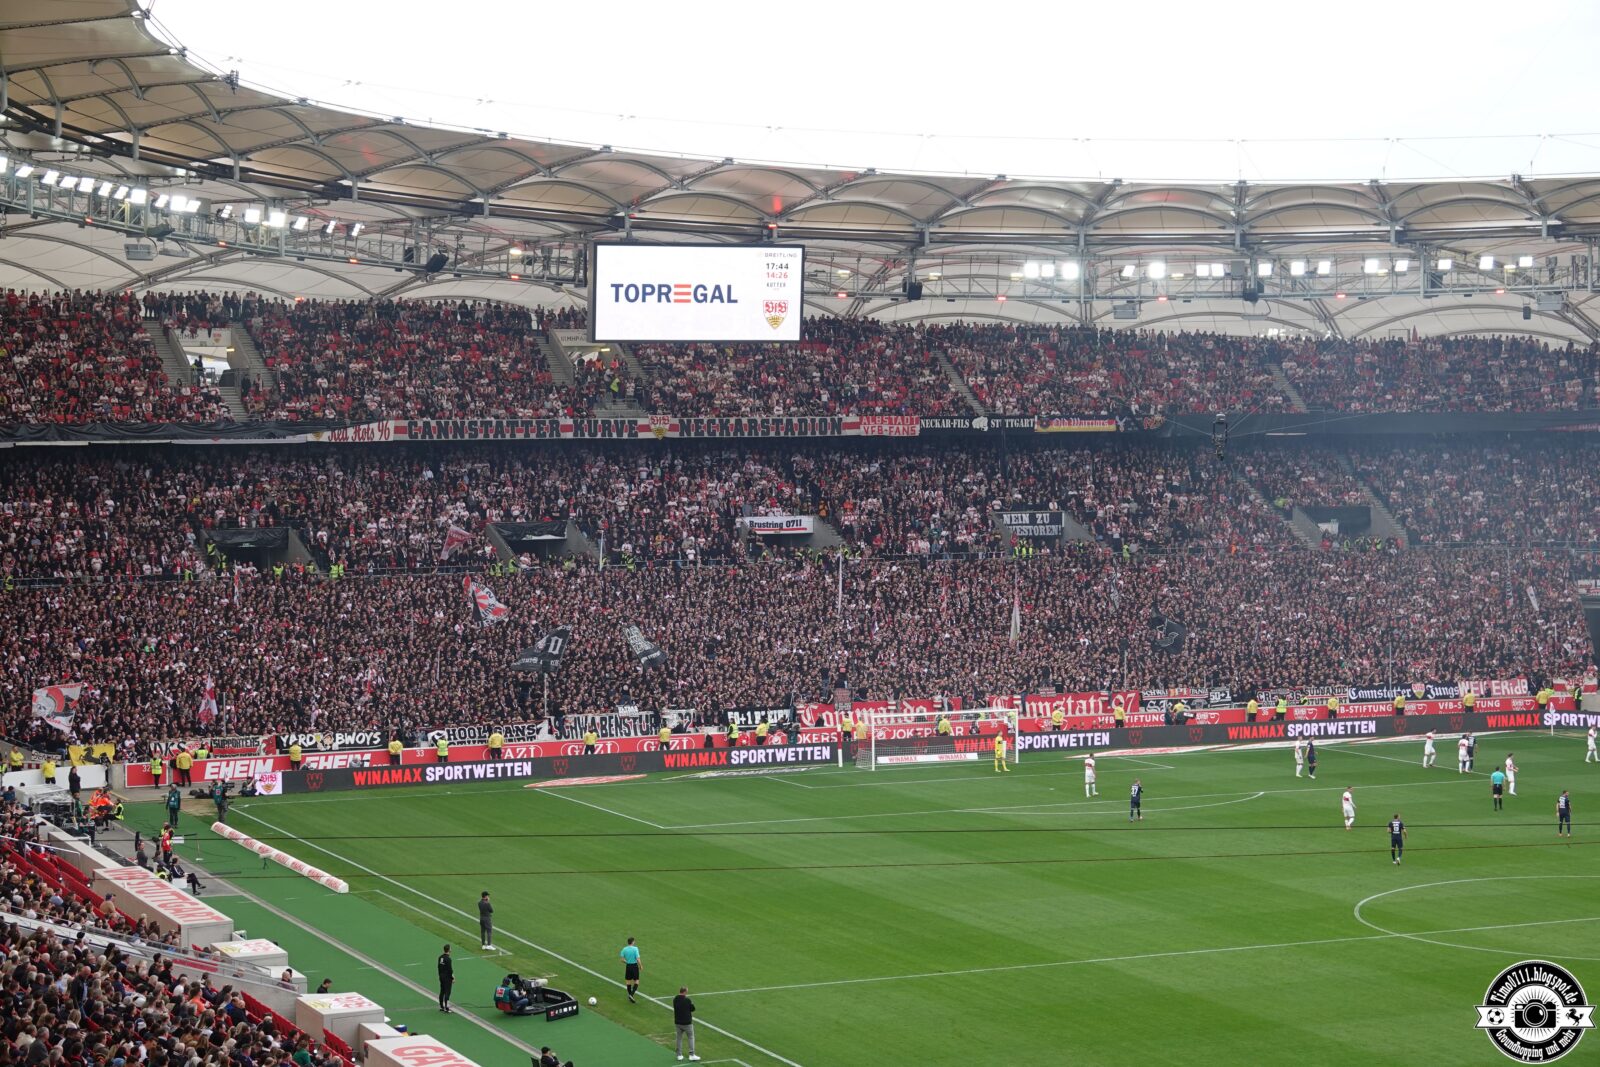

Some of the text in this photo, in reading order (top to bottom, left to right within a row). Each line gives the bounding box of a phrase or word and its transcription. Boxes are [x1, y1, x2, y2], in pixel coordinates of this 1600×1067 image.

[610, 283, 738, 303] TOPREGAL
[408, 418, 638, 440] CANNSTATTER KURVE
[678, 417, 843, 437] NECKARSTADION
[861, 416, 919, 425] ALBSTADT
[921, 416, 1034, 429] NECKAR-FILS STTTGART
[863, 425, 917, 435] VFB-FANS
[786, 519, 802, 527] 0711
[1003, 513, 1050, 524] NEIN ZU
[1210, 691, 1231, 701] 50+1
[1487, 713, 1541, 728] WINAMAX
[1228, 720, 1376, 740] WINAMAX SPORTWETTEN
[280, 731, 382, 749] YARD BWOYS
[953, 732, 1110, 753] WINAMX SPORTWETTEN
[416, 749, 424, 757] 33
[664, 746, 831, 768] WINAMAX SPORTWETTEN
[204, 759, 273, 780] EHEIM
[353, 761, 532, 786] WINAMAX SPORTWETTEN
